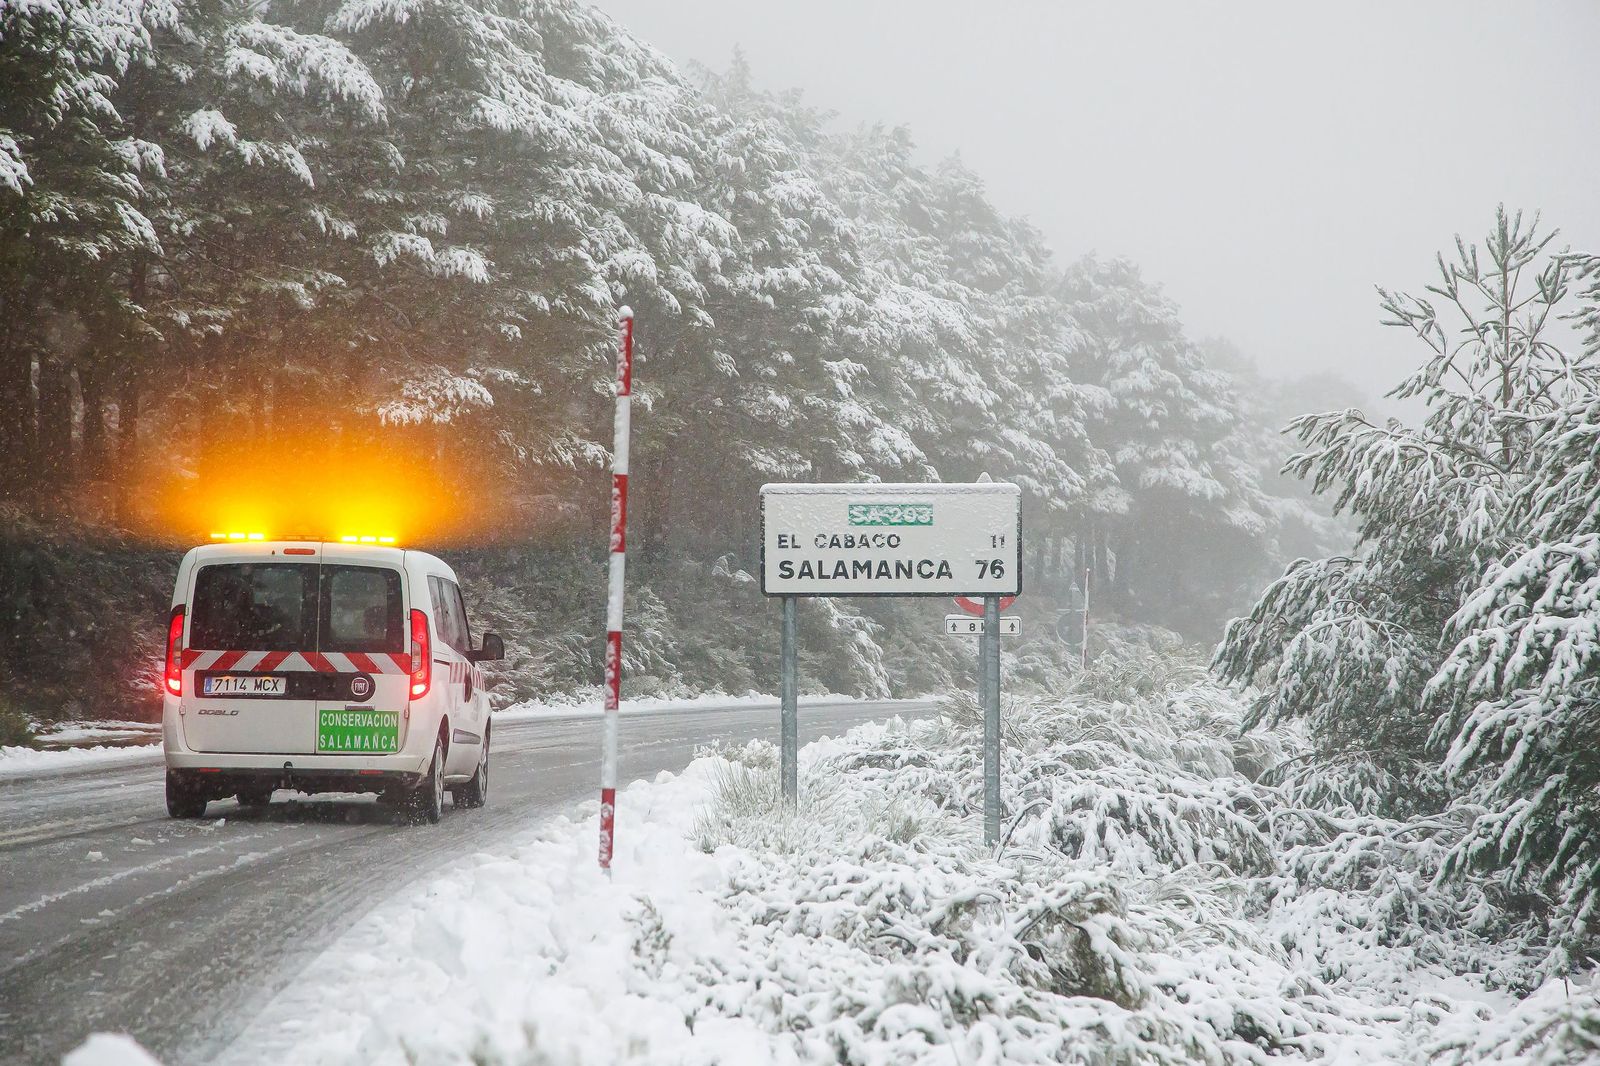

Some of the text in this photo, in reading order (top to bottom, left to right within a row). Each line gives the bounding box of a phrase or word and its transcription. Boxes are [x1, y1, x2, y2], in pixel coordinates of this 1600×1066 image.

[777, 534, 1006, 549] EL CABACO 11
[778, 559, 1005, 580] SALAMANCA 76
[969, 622, 976, 631] 8
[214, 679, 280, 692] 7114 MCX
[354, 683, 365, 691] FIAT
[321, 712, 397, 727] CONSERVACION
[319, 734, 397, 749] SALAMANCA
